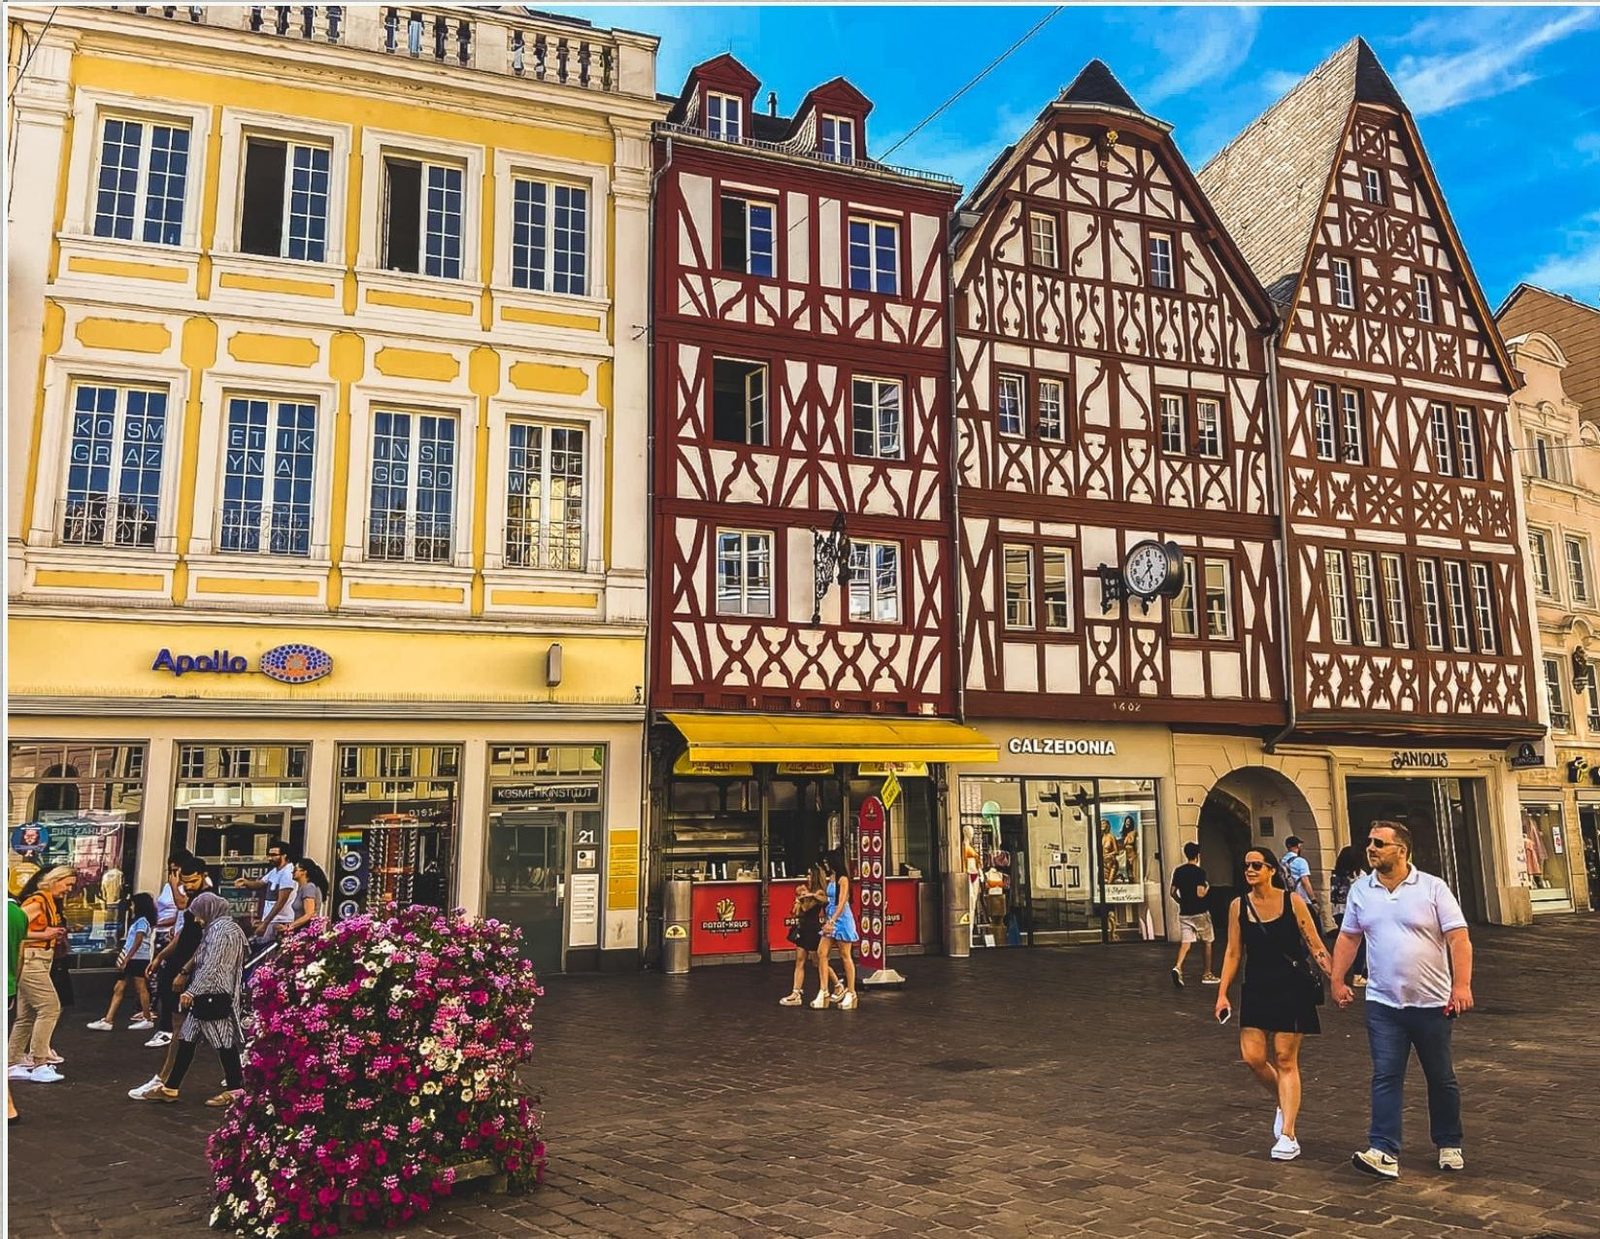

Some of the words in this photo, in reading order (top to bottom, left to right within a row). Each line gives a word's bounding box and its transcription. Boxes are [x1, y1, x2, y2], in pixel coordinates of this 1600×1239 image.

[76, 417, 164, 440] KOSM
[231, 428, 311, 451] ETIK
[380, 441, 452, 462] INST
[73, 443, 161, 466] GRAZ
[229, 454, 291, 475] YNA
[152, 648, 247, 677] Apollo
[1008, 738, 1116, 755] CALZEDONIA
[51, 827, 73, 836] EINE
[578, 829, 594, 844] 21
